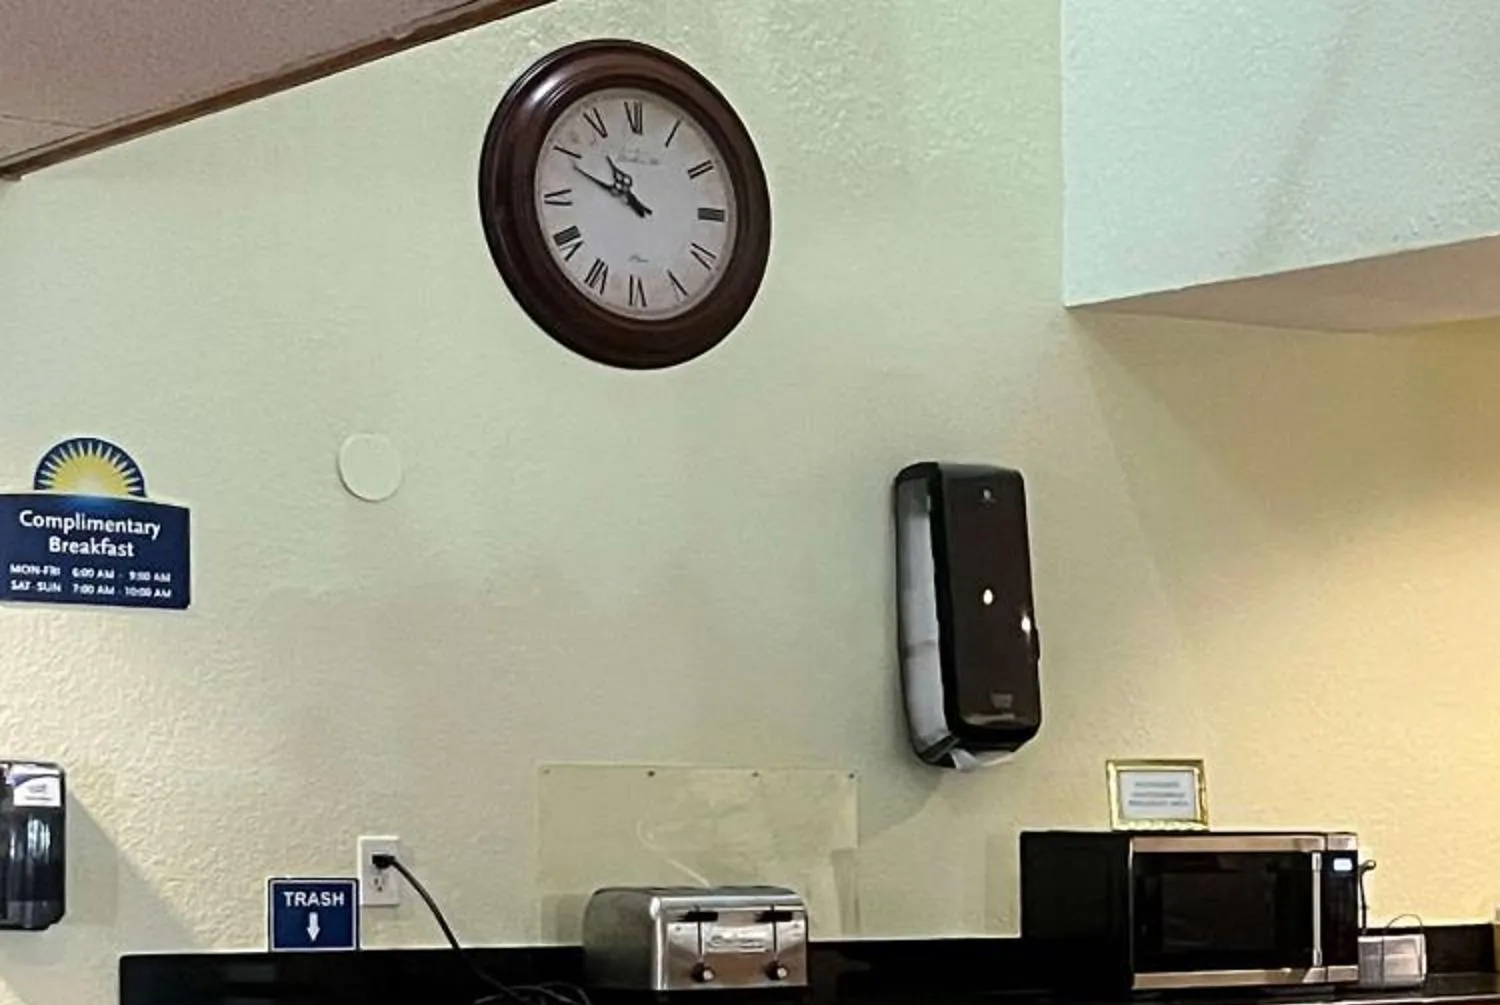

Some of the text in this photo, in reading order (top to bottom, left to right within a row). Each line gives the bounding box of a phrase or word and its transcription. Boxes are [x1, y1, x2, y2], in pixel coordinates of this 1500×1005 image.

[19, 509, 161, 541] Complimentary
[49, 536, 135, 558] Breakfast
[96, 568, 115, 580] AM
[154, 571, 171, 583] AM
[97, 583, 115, 596] AM
[153, 587, 172, 599] AM
[283, 891, 345, 907] TRASH
